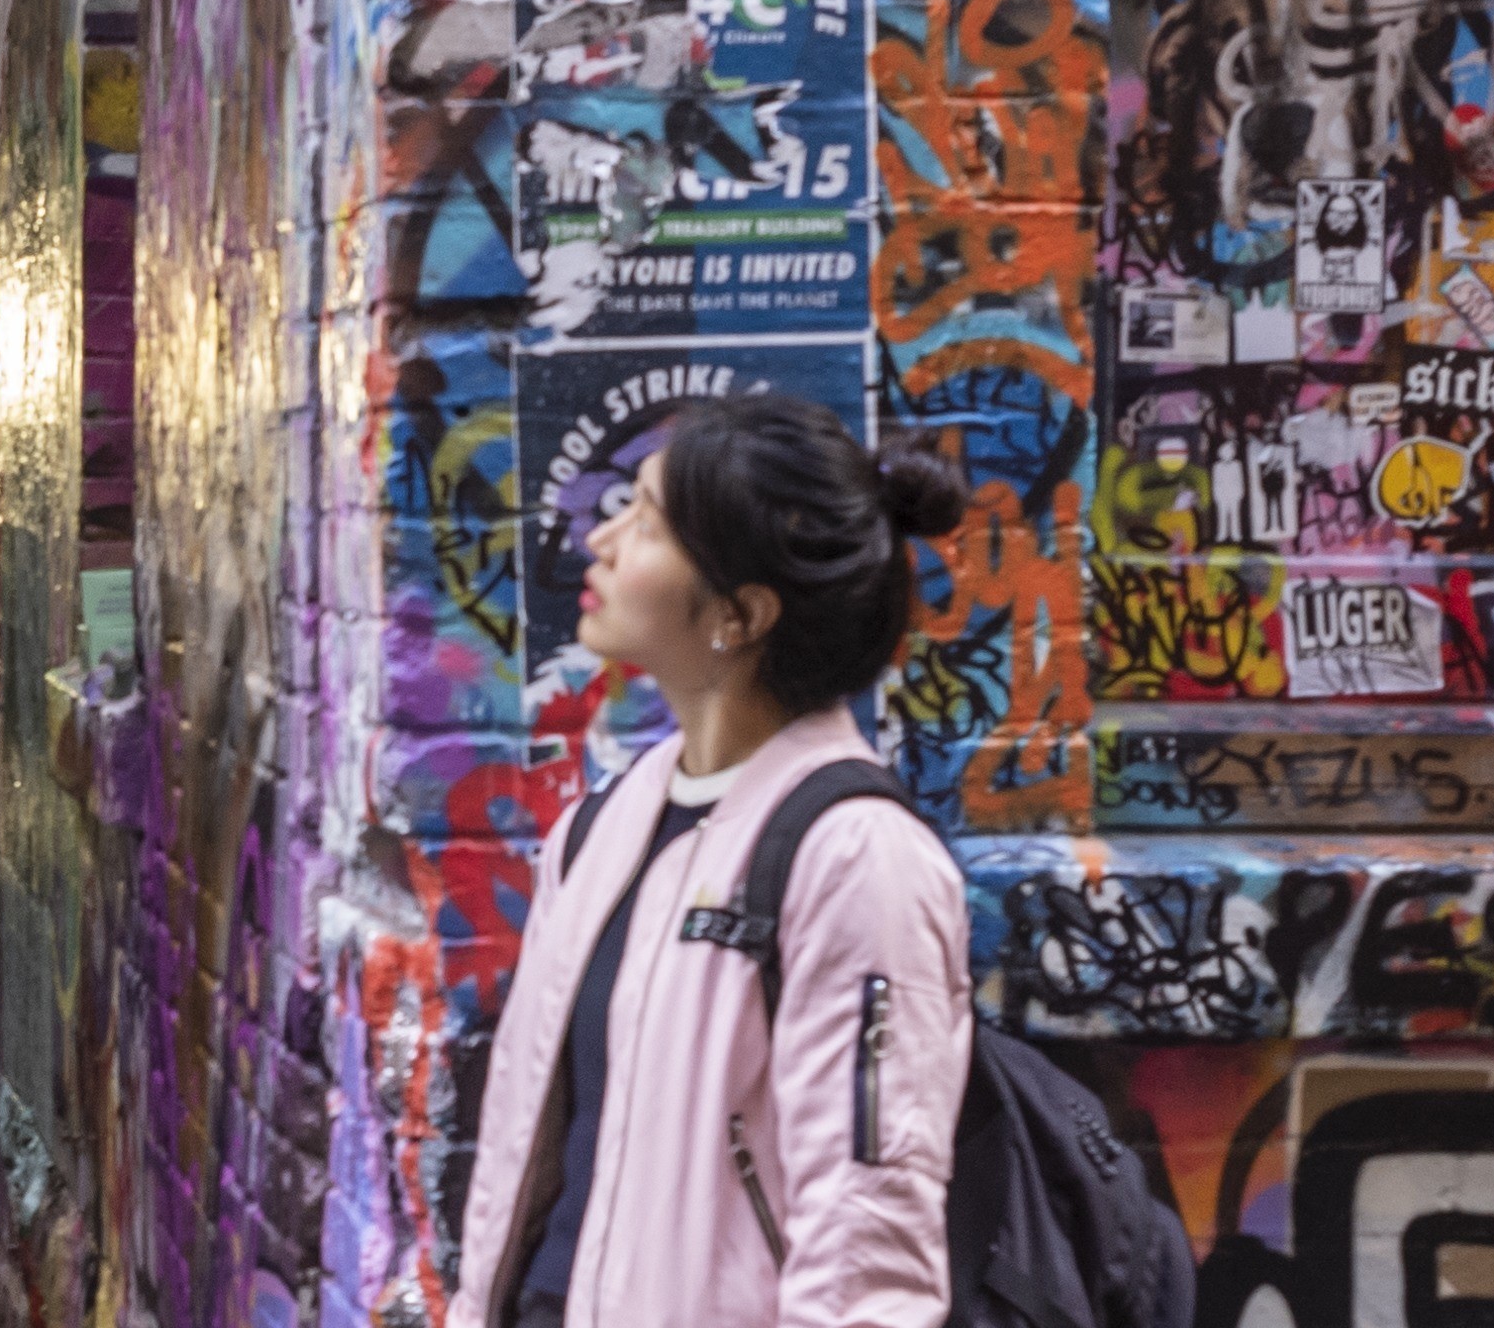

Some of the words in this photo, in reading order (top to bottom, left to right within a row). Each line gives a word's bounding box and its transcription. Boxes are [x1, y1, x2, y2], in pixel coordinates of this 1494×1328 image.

[781, 144, 852, 199] 15
[663, 220, 753, 237] TREASURY
[756, 218, 845, 235] BUILDING
[702, 254, 733, 284] IS
[739, 251, 858, 283] INVITED
[639, 295, 686, 312] DATE
[689, 293, 734, 311] SAVE
[739, 292, 770, 309] THE
[773, 290, 840, 308] PLANET
[603, 365, 735, 423] STRIKE
[1296, 588, 1410, 650] LUGER
